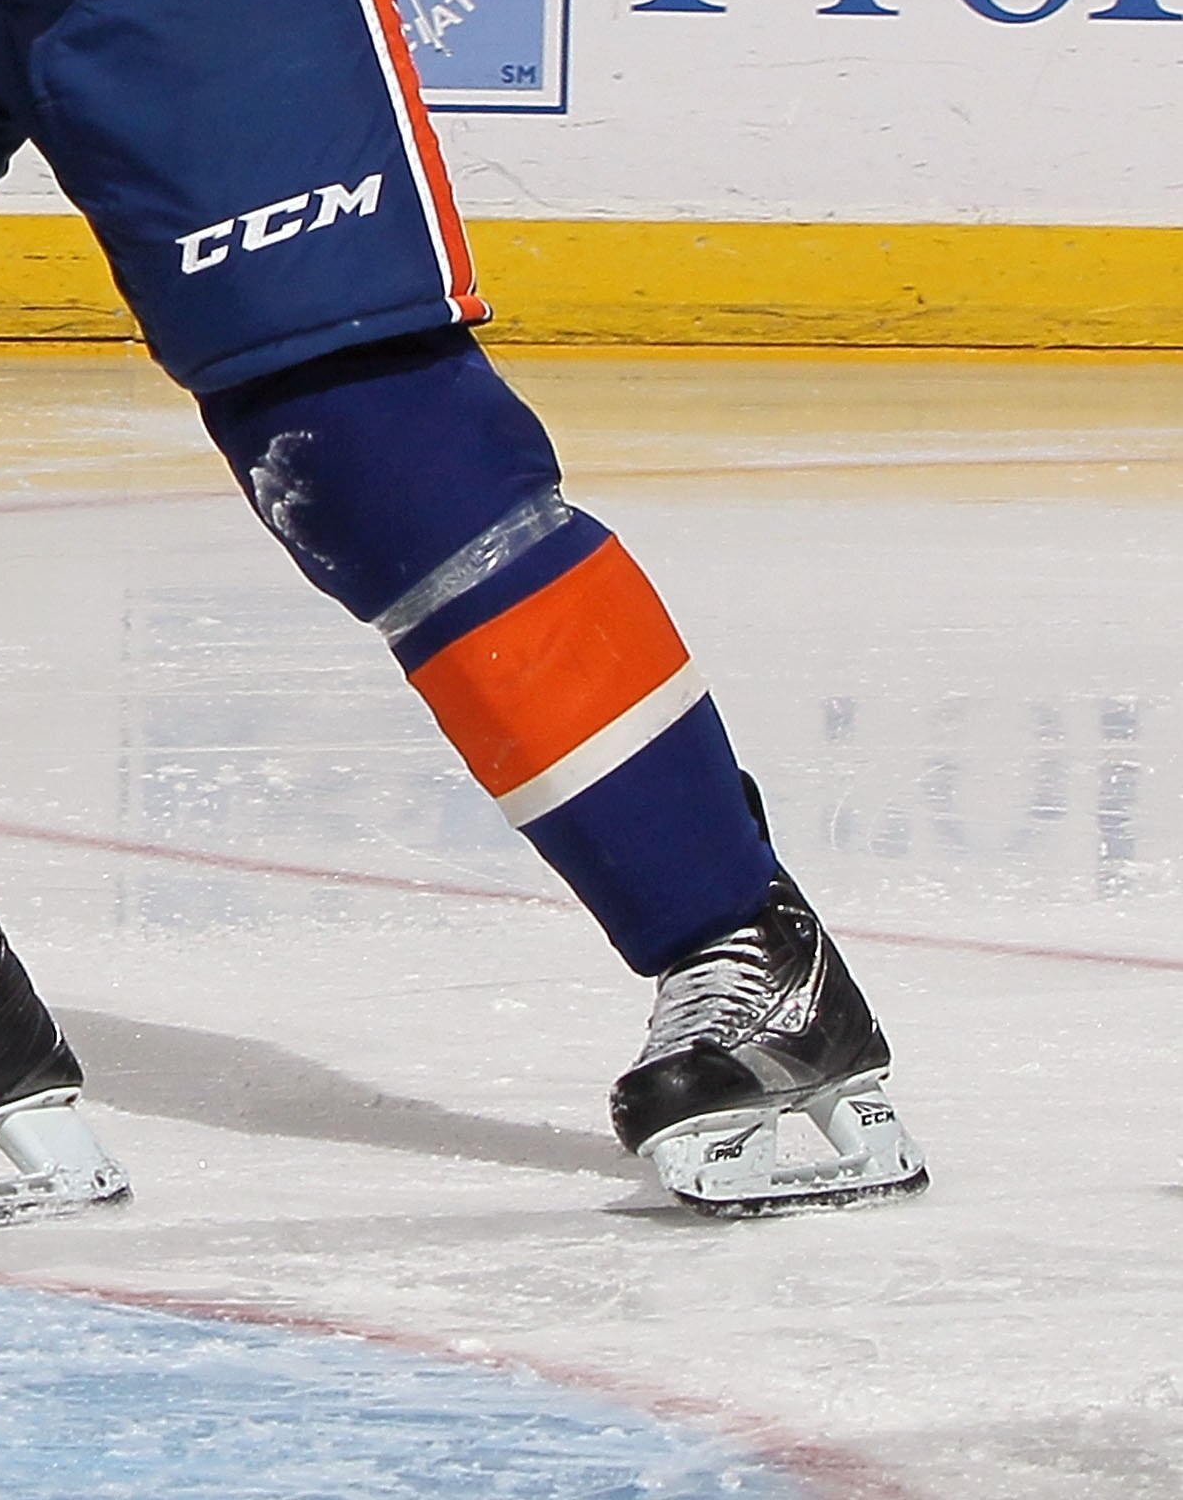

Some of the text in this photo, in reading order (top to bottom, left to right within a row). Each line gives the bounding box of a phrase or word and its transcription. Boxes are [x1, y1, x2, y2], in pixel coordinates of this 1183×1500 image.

[501, 64, 536, 84] SM
[175, 174, 382, 274] CCM
[861, 1110, 895, 1126] CCM
